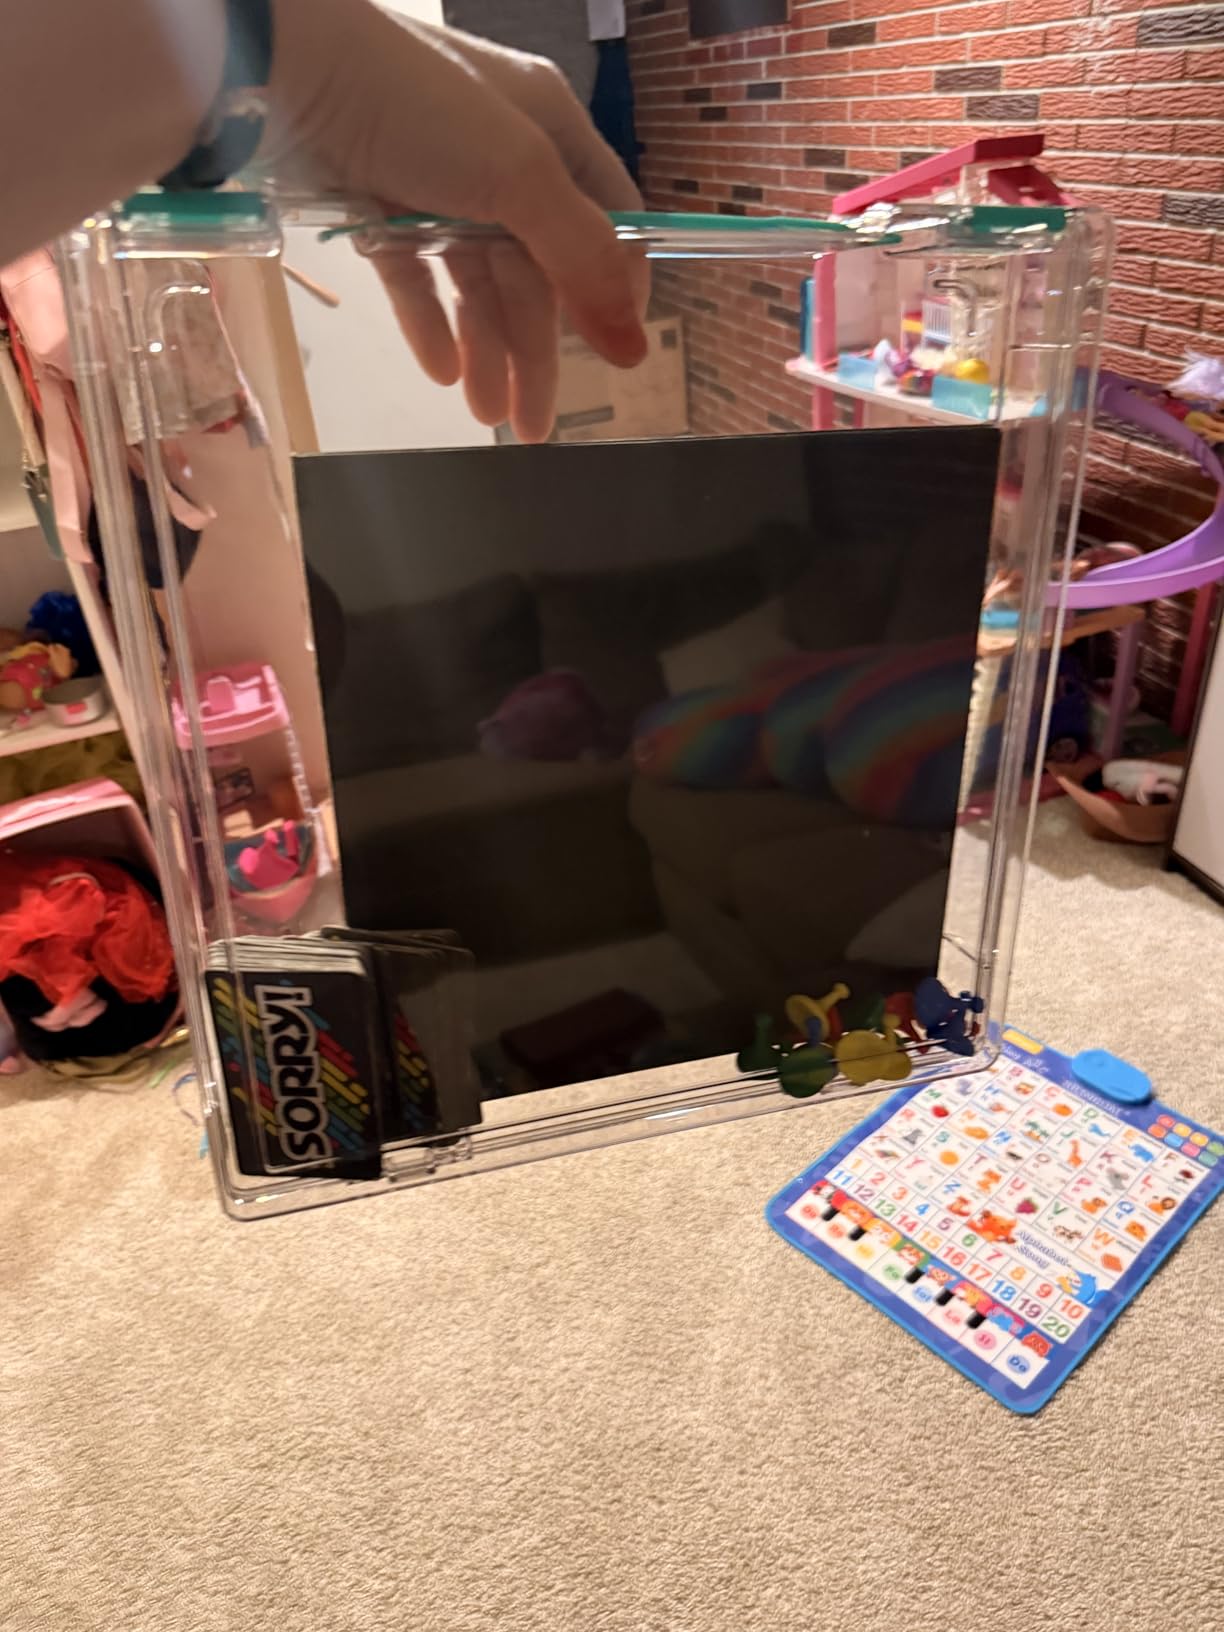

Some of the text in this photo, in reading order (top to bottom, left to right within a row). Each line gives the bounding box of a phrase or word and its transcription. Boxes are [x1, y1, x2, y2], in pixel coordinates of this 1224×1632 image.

[254, 984, 333, 1161] SORRY!
[1010, 1177, 1026, 1190] U
[1053, 1201, 1068, 1215] V
[1117, 1200, 1135, 1214] Q
[851, 1158, 1084, 1320] 1 2 3 4 5 6 7 8 9 10
[1094, 1228, 1116, 1246] W
[833, 1170, 1070, 1338] 11 12 13 14 15 16 17 18 19 20
[1008, 1356, 1028, 1373] Do
